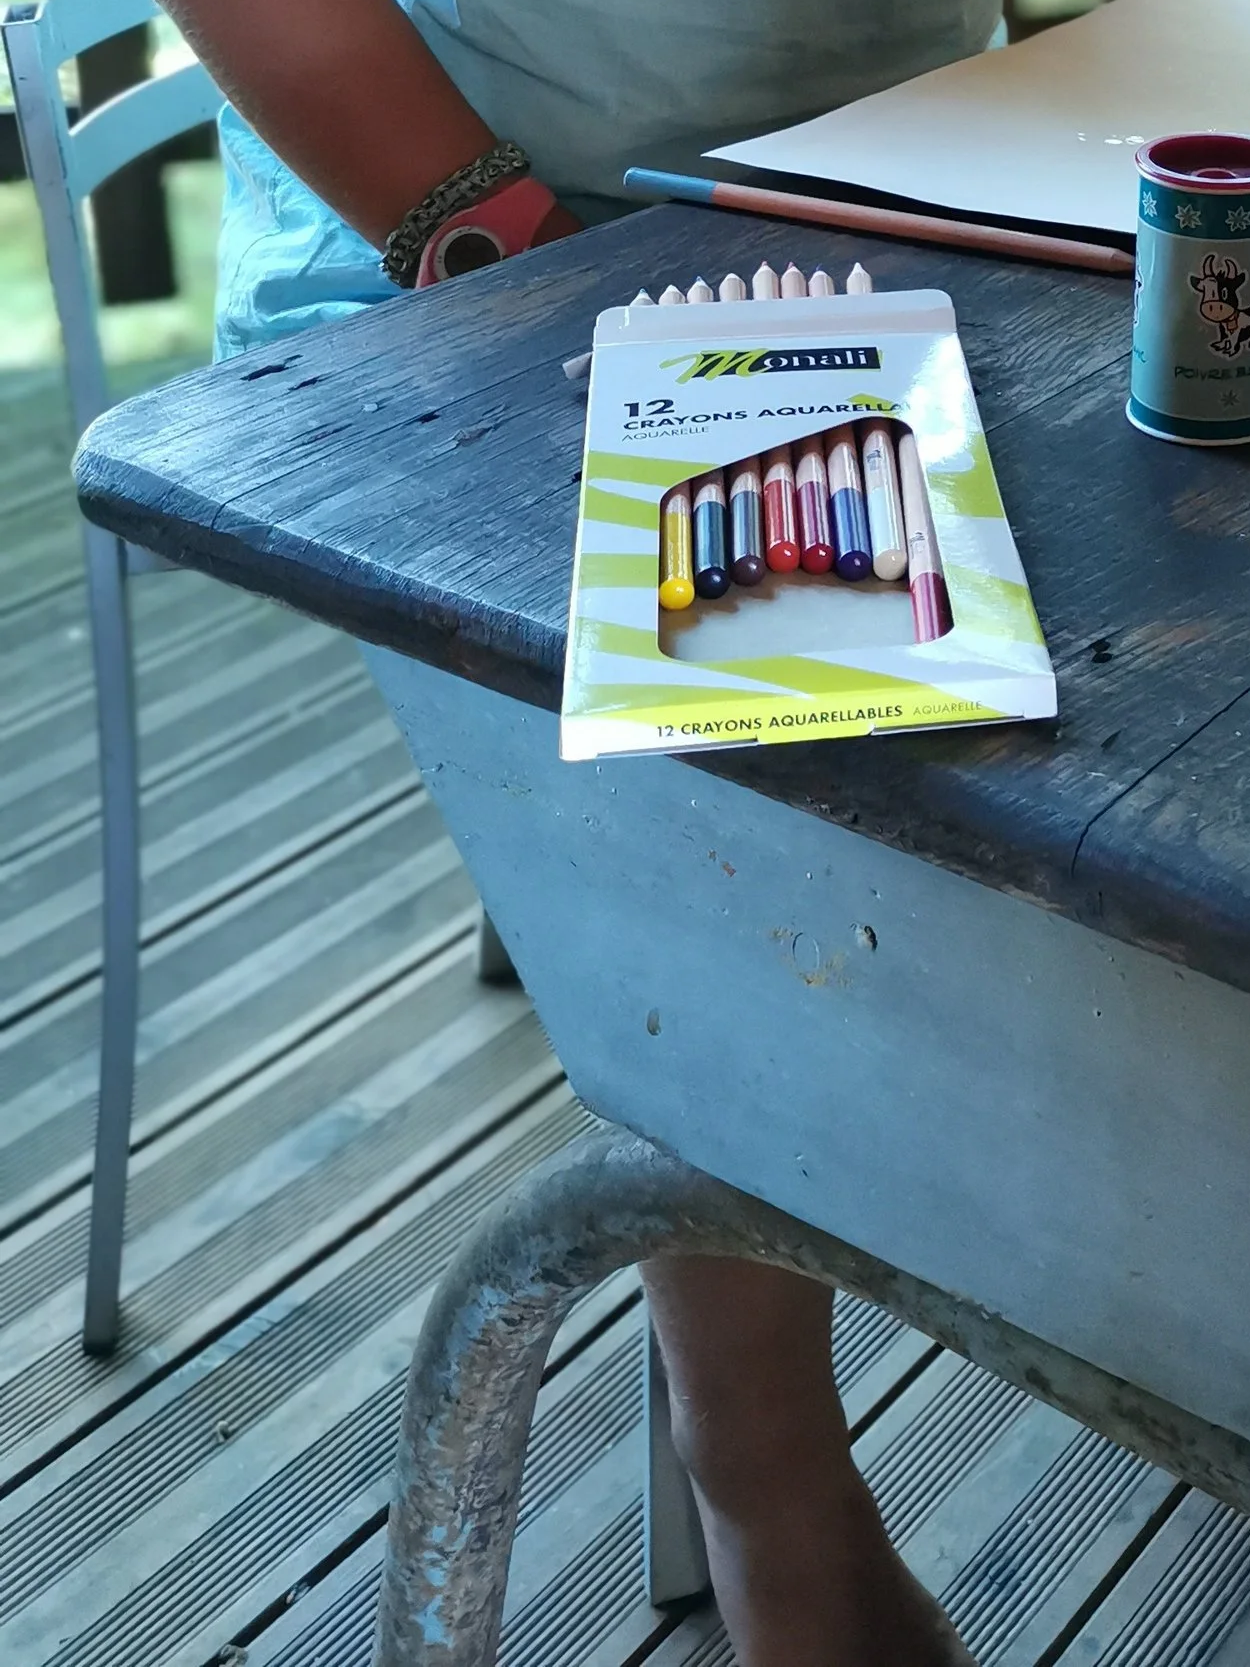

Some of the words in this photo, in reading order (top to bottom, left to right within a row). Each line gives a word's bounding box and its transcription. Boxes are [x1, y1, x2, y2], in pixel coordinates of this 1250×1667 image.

[659, 347, 868, 384] Monali
[1174, 365, 1233, 381] POIVRE
[624, 399, 675, 417] 12
[623, 410, 748, 430] CRAYONS
[621, 425, 710, 442] AQUARELLE
[657, 725, 675, 737] 12
[681, 717, 762, 735] CRAYONS
[768, 705, 903, 728] AQUARELLABLES
[913, 700, 983, 716] AQUARELLE
